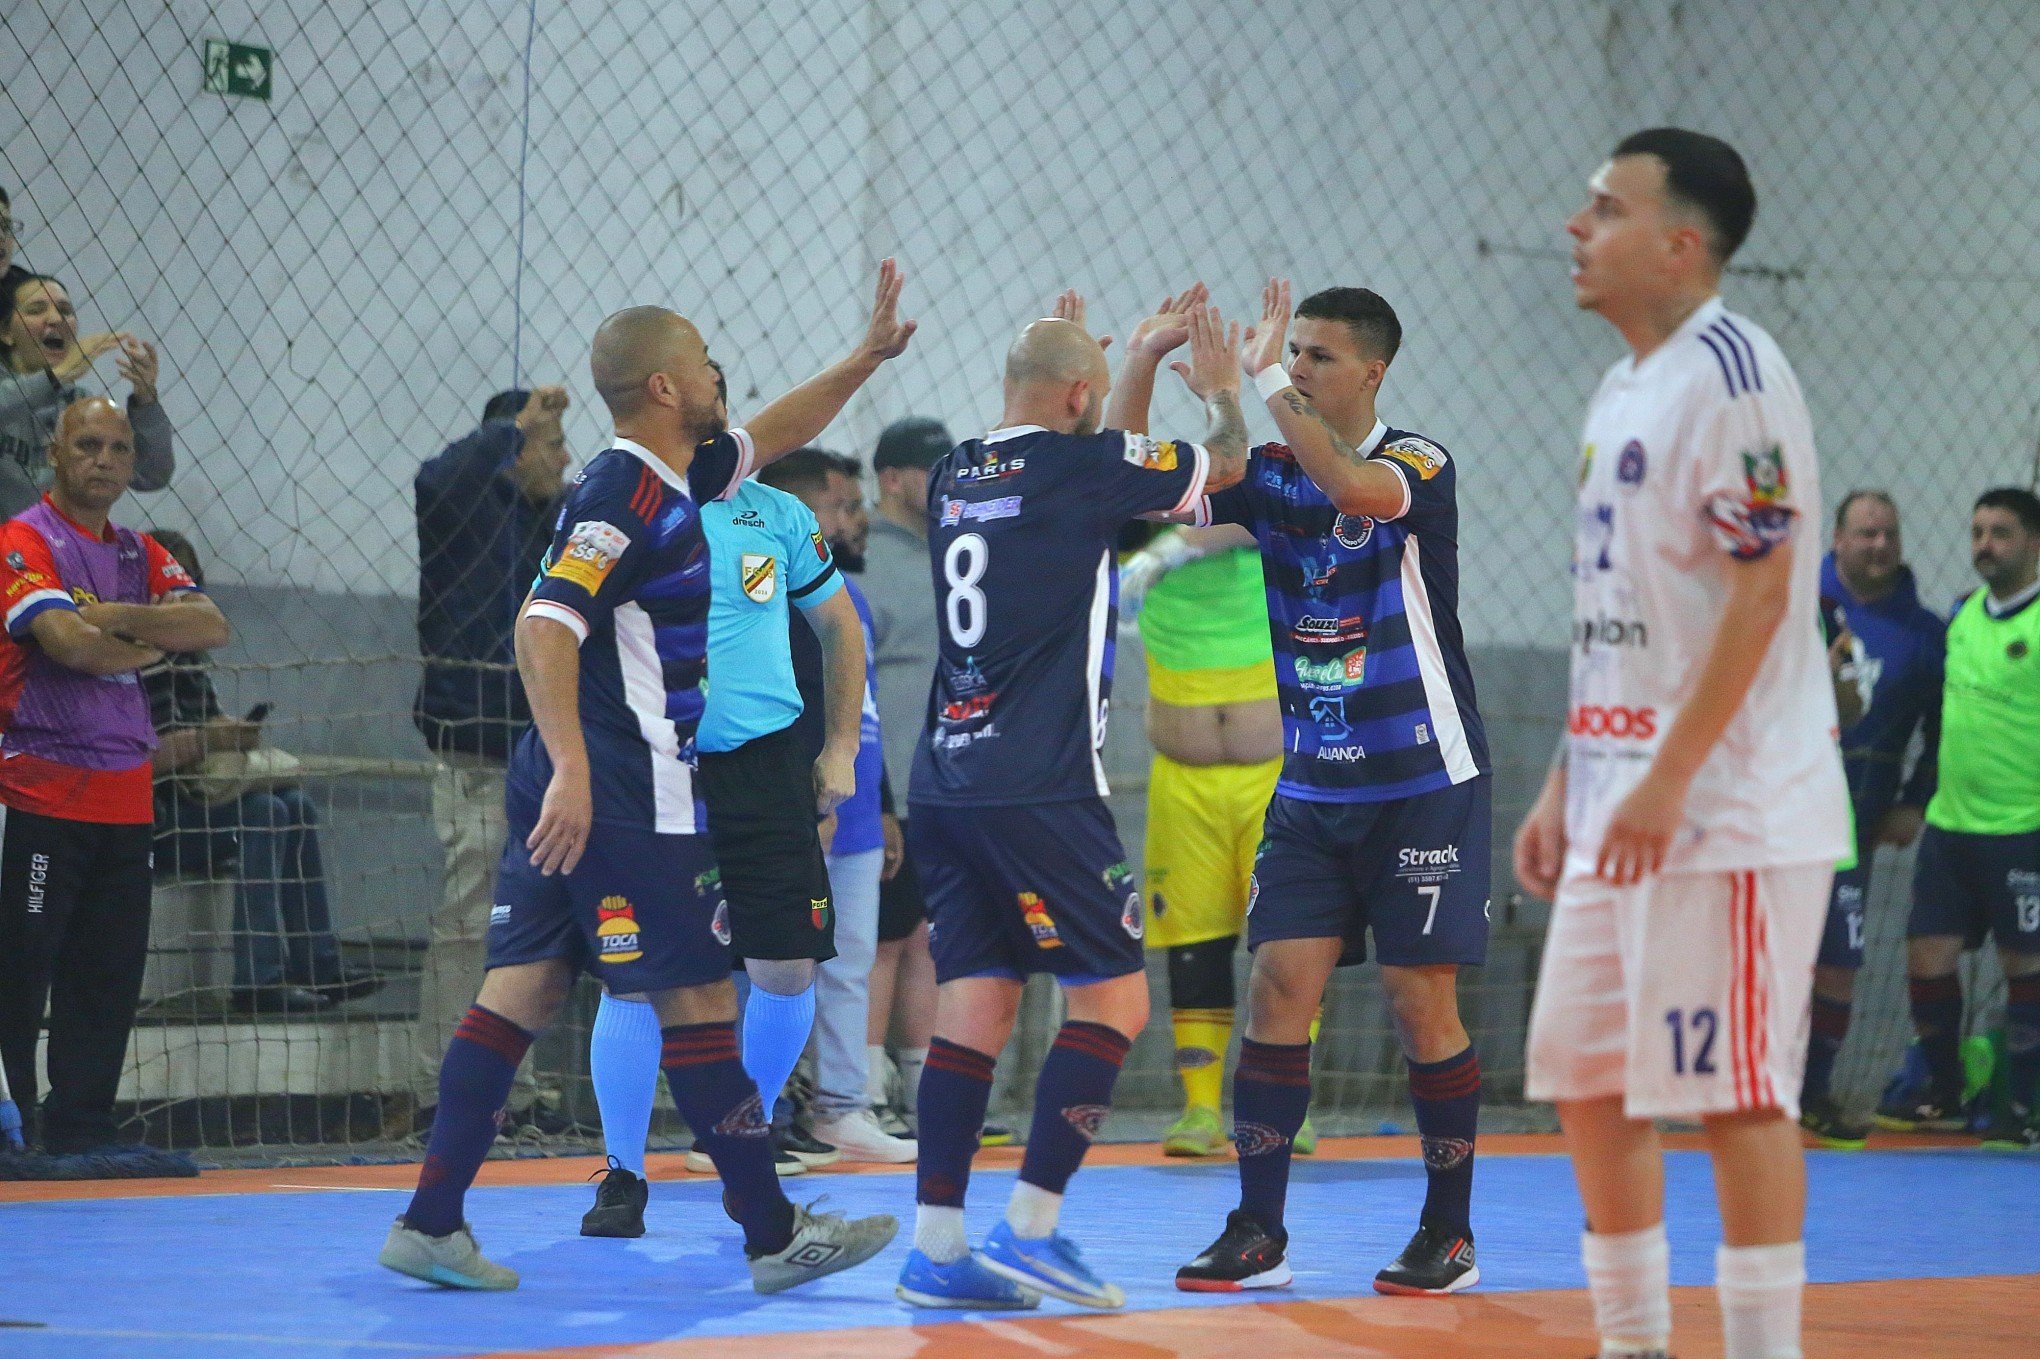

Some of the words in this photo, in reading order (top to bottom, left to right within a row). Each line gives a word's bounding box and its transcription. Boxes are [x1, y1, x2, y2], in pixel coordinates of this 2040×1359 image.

[957, 459, 1025, 478] PARIS
[732, 517, 765, 528] dresch
[944, 533, 989, 648] 8
[1573, 609, 1649, 655] pion
[1317, 745, 1366, 762] ALIANÇA
[1398, 844, 1459, 868] Strack
[28, 853, 50, 913] HILFIGER
[1418, 886, 1441, 935] 7
[602, 934, 638, 948] TOCA
[1666, 1006, 1718, 1075] 12
